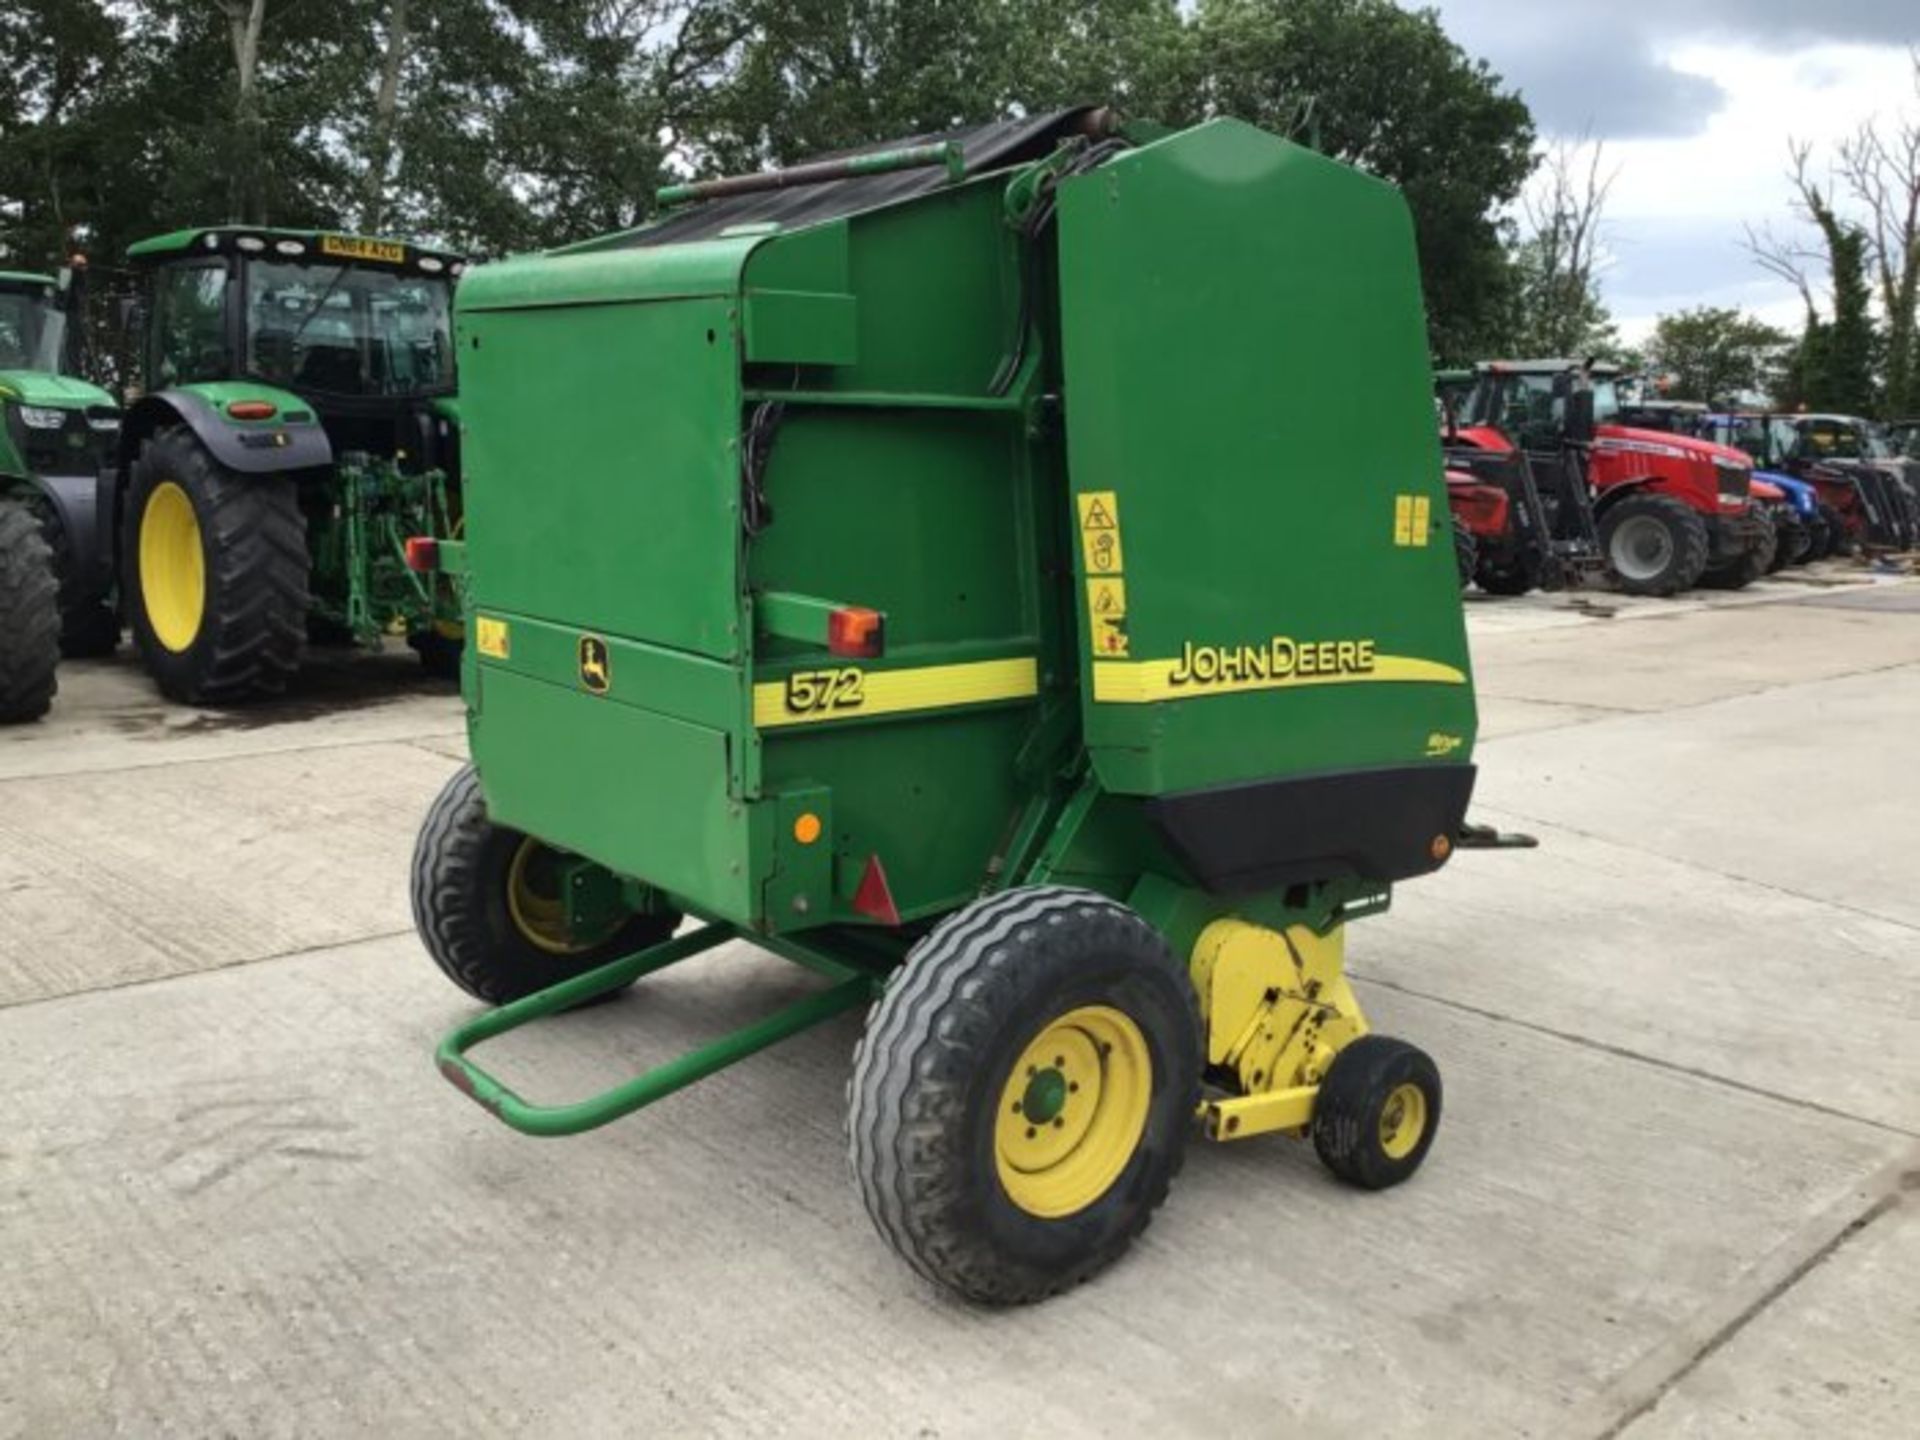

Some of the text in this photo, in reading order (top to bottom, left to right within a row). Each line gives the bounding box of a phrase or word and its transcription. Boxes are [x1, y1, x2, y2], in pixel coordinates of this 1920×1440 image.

[1170, 635, 1375, 683] JOHN DEERE
[787, 667, 864, 713] 572
